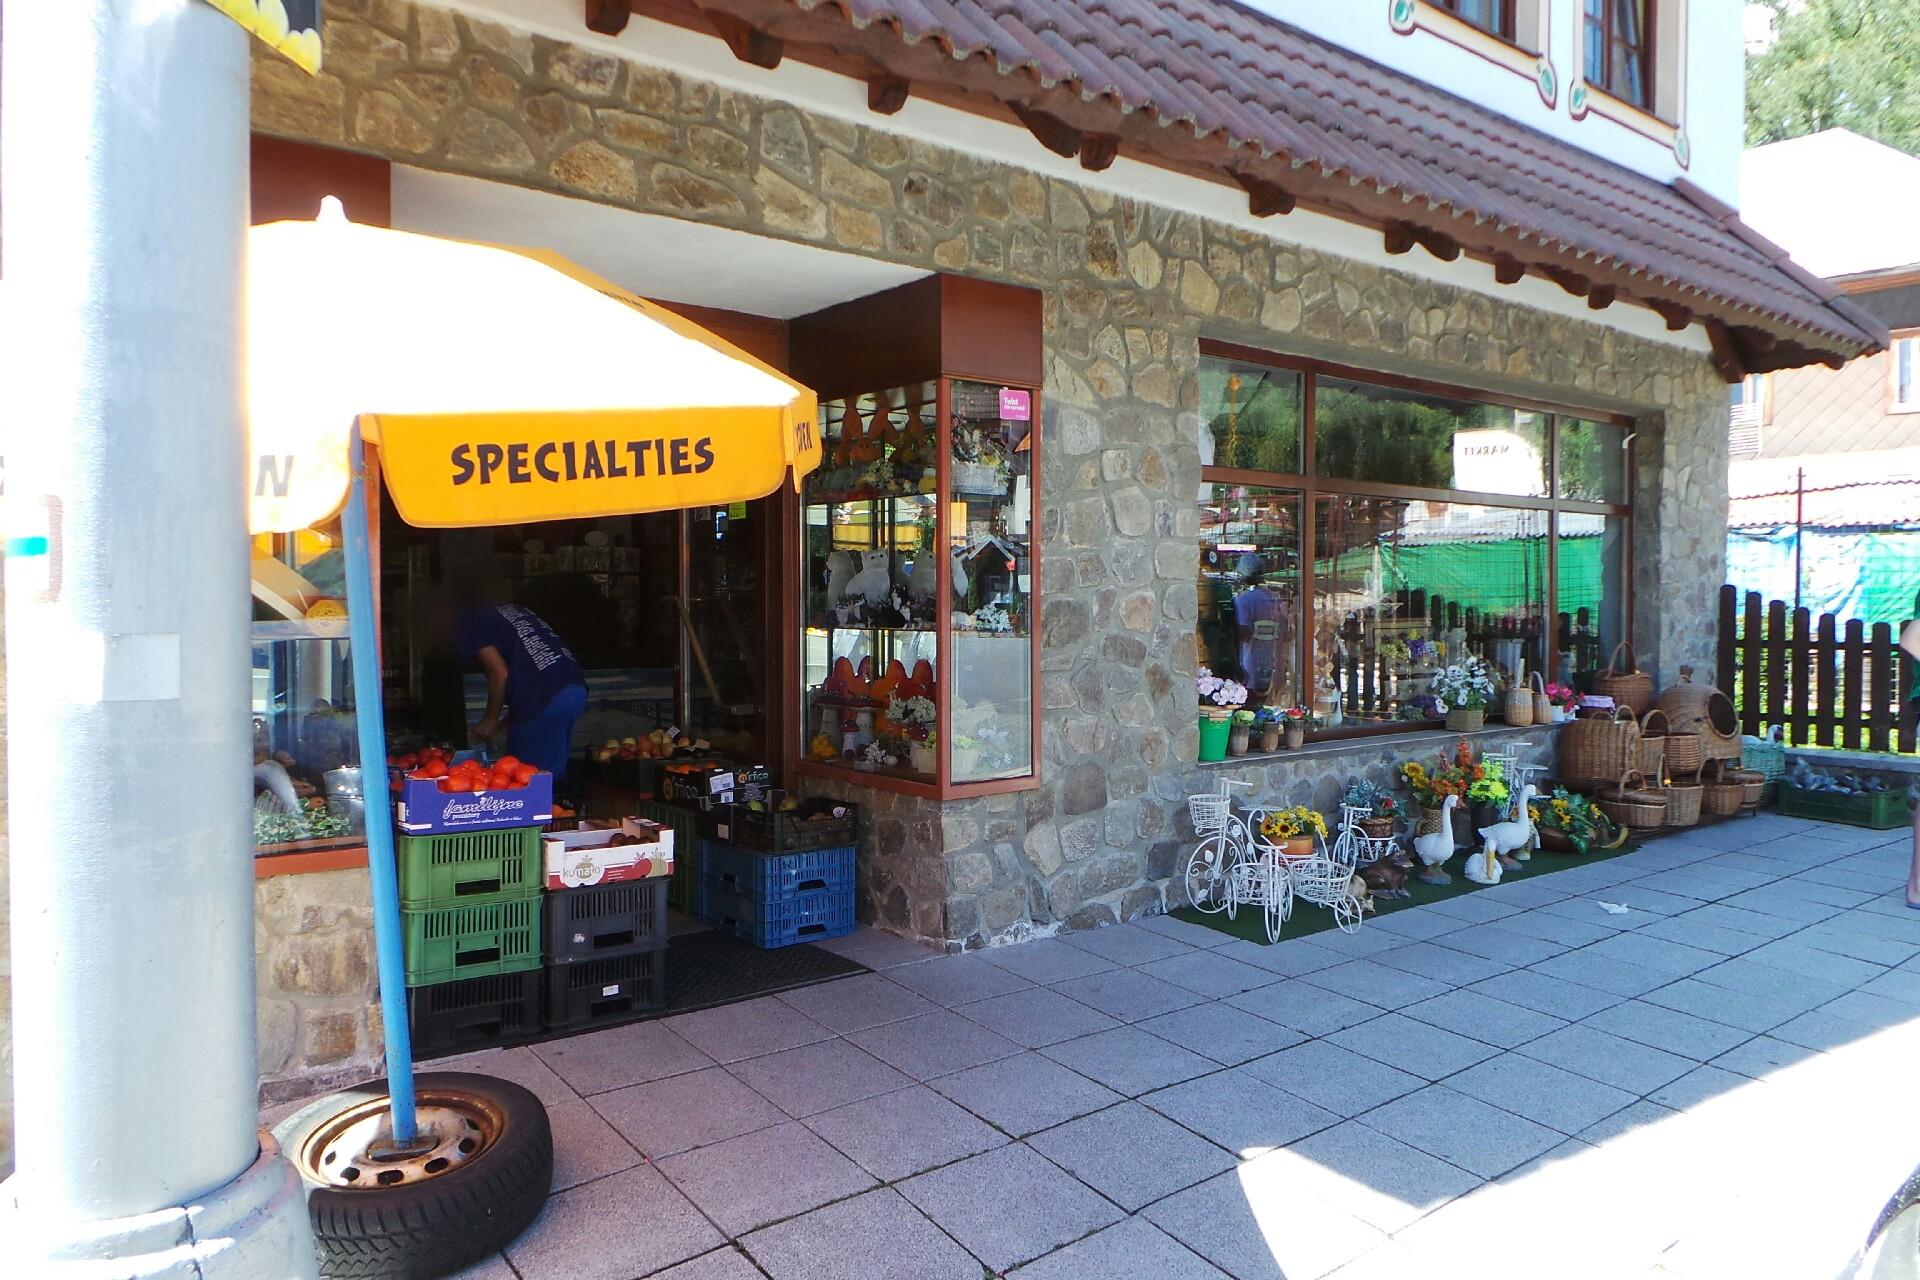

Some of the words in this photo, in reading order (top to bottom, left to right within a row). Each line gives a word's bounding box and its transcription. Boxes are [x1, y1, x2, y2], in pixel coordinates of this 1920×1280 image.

[451, 437, 715, 485] SPECIALTIES
[442, 796, 524, 819] familijne
[563, 866, 601, 878] kumato
